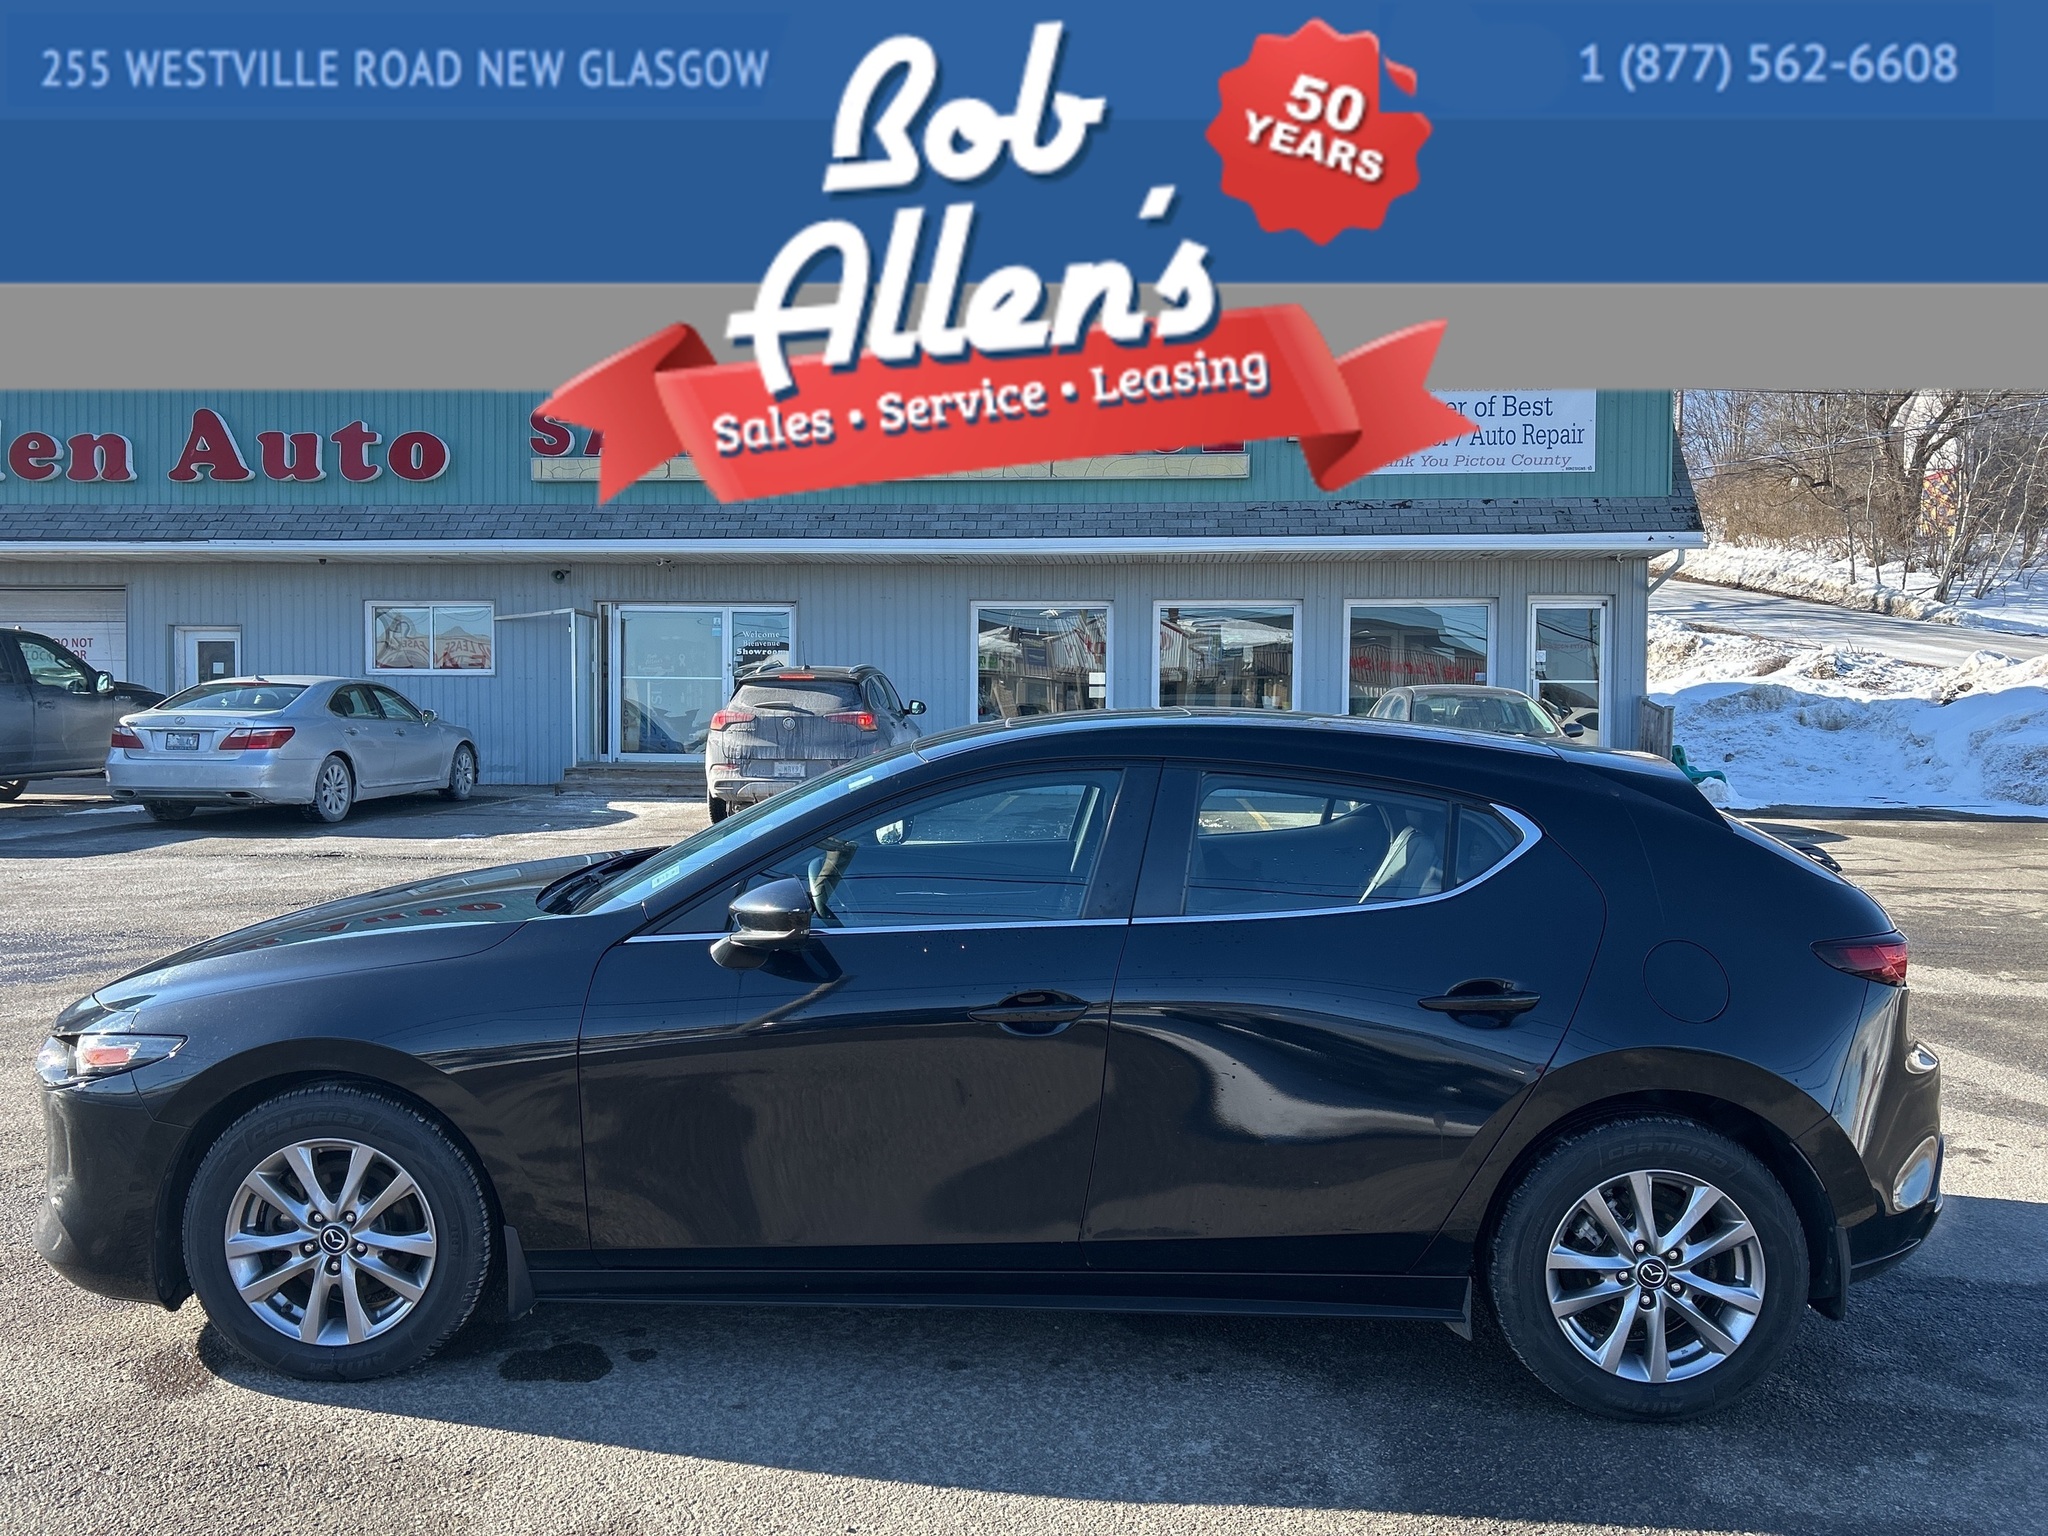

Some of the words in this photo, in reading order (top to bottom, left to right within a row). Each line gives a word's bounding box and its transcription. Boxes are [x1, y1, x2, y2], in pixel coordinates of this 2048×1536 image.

[1474, 396, 1498, 418] of
[1502, 395, 1554, 417] Best
[1469, 424, 1517, 446] Auto
[1522, 422, 1586, 450] Repair
[6, 429, 137, 483] en
[166, 407, 451, 483] Auto
[1420, 455, 1452, 467] You
[1453, 454, 1508, 467] Pictou
[1511, 453, 1573, 468] County
[742, 630, 780, 638] Welcome
[71, 637, 94, 648] NOT
[742, 639, 781, 647] Bienvenue
[736, 648, 789, 656] Showroom
